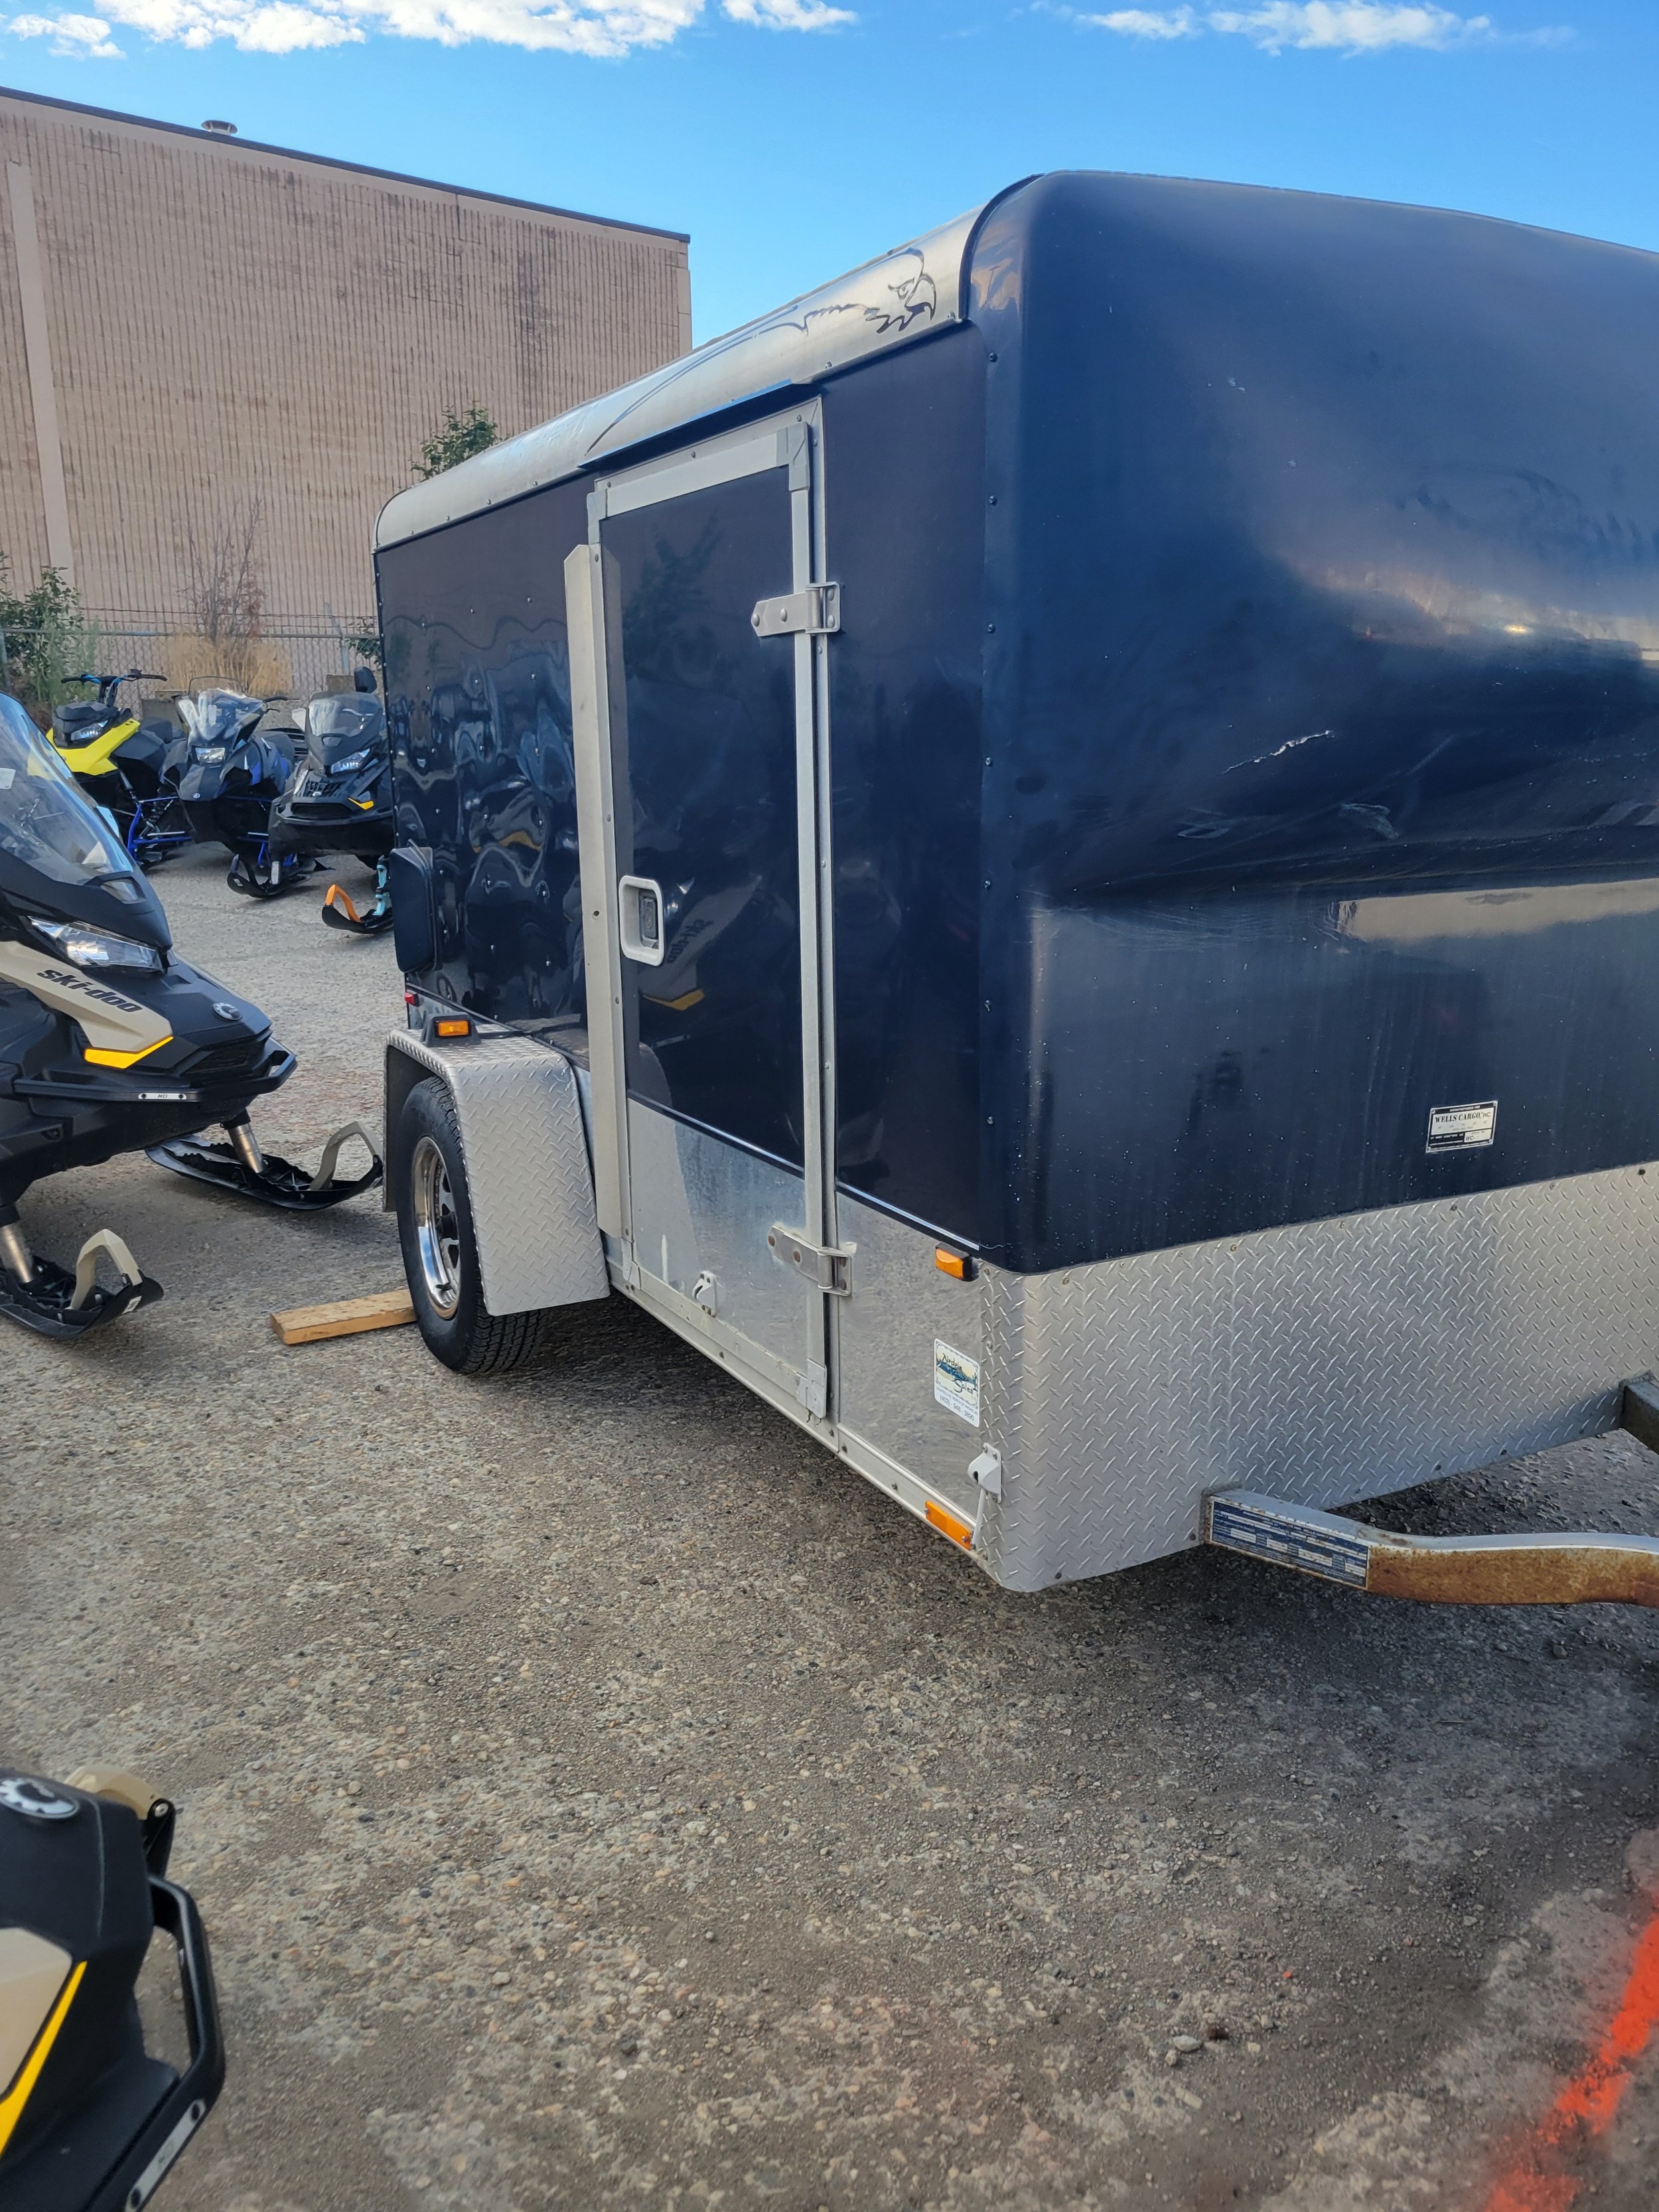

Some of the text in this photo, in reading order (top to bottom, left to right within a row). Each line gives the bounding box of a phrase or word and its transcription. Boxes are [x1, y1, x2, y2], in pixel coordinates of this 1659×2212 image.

[36, 970, 143, 1012] ski-doo
[1435, 1114, 1457, 1123] WELLS
[942, 1353, 962, 1370] Airdrie
[954, 1378, 974, 1394] Sales
